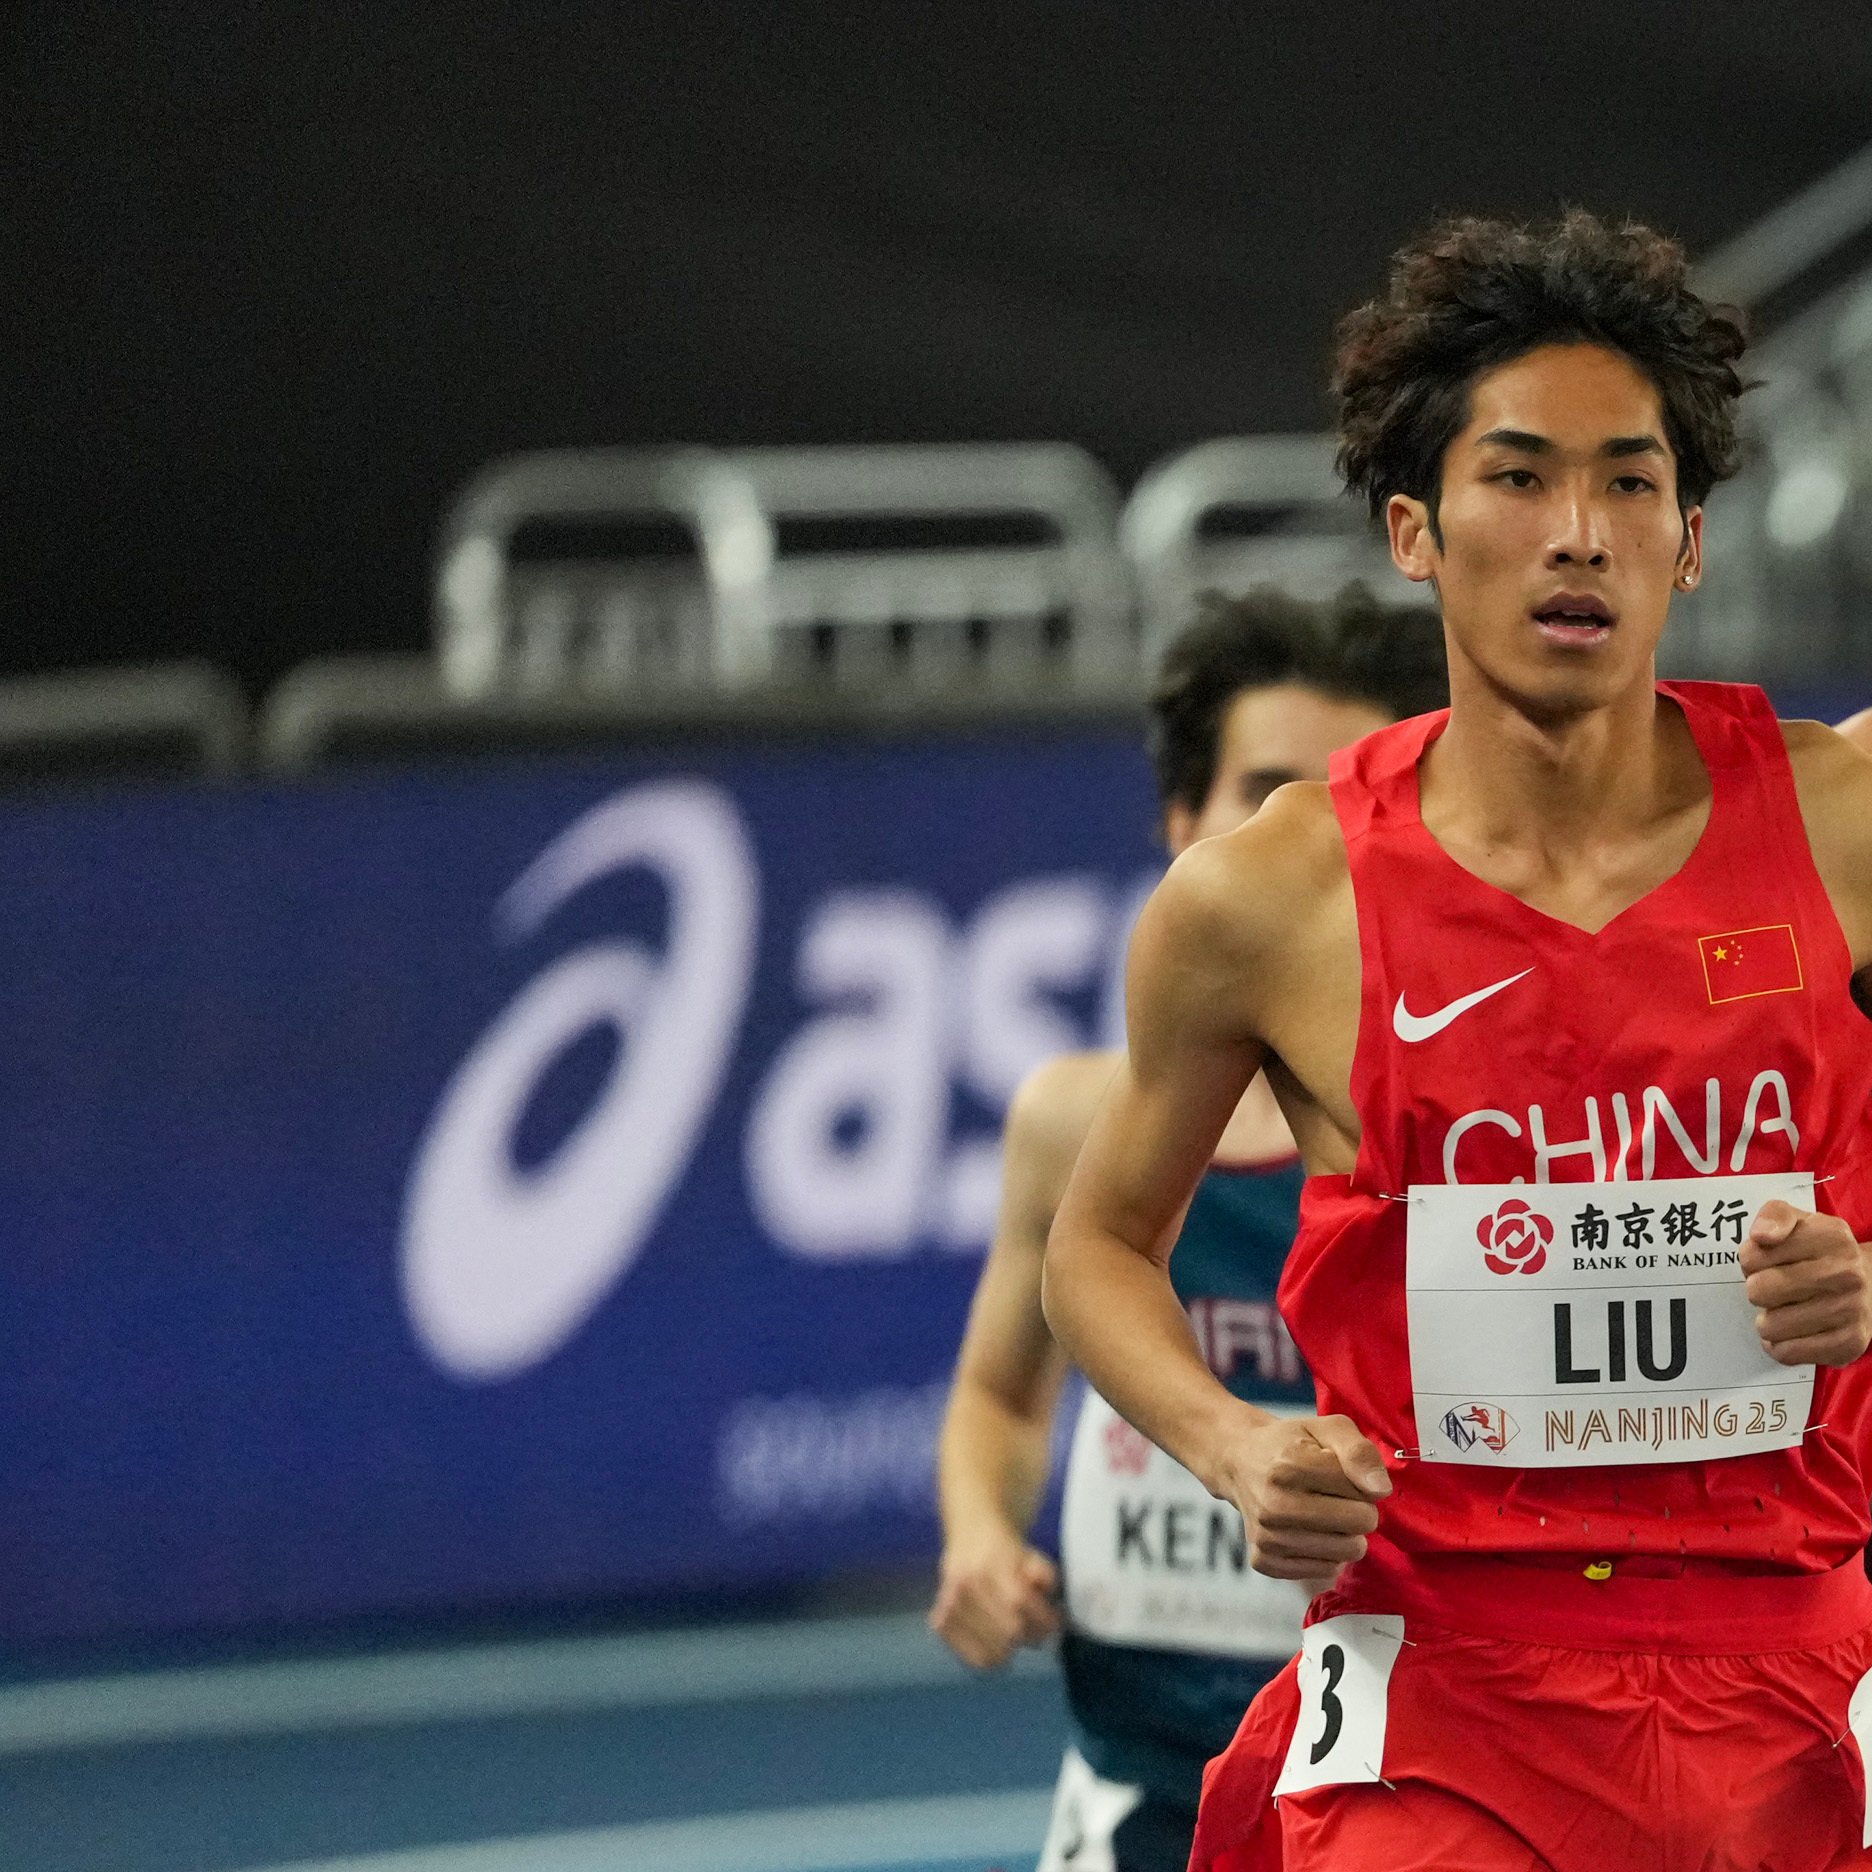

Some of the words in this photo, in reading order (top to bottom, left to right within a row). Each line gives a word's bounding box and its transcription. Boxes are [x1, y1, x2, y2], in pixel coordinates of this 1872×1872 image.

[743, 870, 1130, 1264] as
[1443, 1069, 1800, 1184] CHINA
[1571, 1199, 1749, 1251] 南京银行
[1572, 1255, 1627, 1271] BANK
[1635, 1254, 1659, 1269] OF
[1553, 1297, 1687, 1385] LIU
[1545, 1398, 1738, 1451] NANJING
[1745, 1399, 1788, 1436] 25
[1115, 1500, 1247, 1574] KEN
[1310, 1643, 1346, 1766] 3
